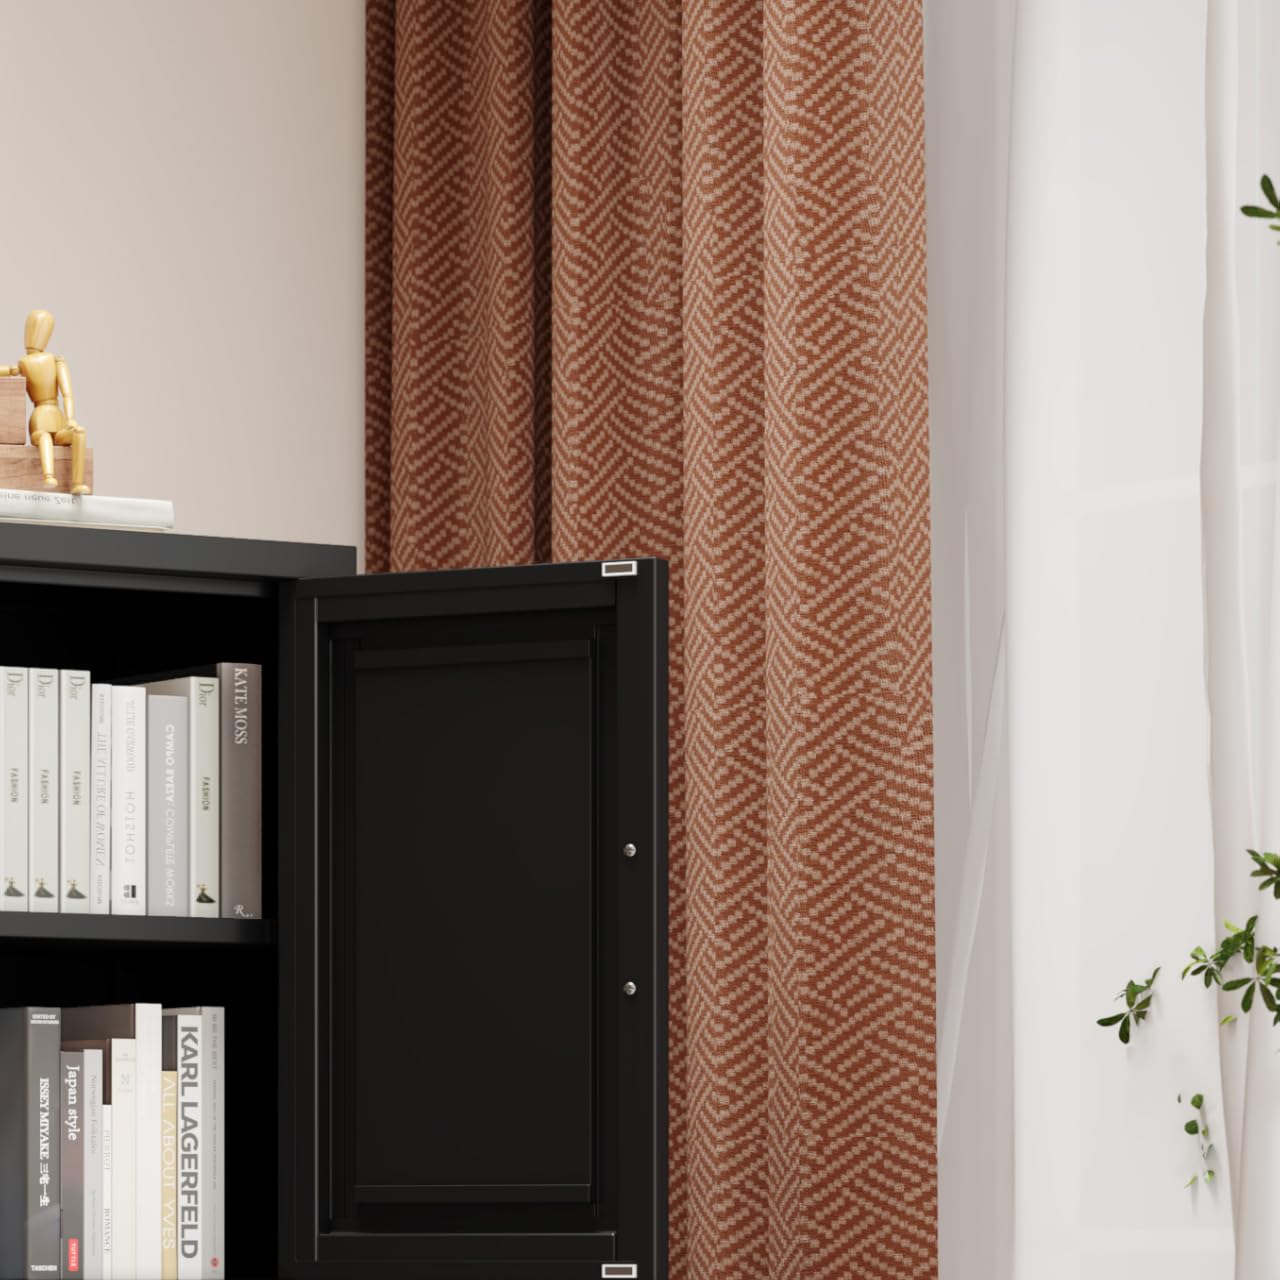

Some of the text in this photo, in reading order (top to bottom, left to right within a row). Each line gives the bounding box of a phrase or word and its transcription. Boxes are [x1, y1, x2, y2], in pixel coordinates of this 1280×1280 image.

[7, 672, 23, 696] Dior
[37, 674, 54, 698] Dior
[70, 675, 85, 700] Dior
[199, 682, 215, 706] Dior
[234, 667, 248, 745] KATE MOSS
[10, 768, 19, 803] FASHION
[40, 769, 49, 804] FASHION
[73, 770, 82, 805] FASHION
[202, 777, 211, 812] FASHION
[39, 1077, 49, 1160] ISSEY MIYAKE
[65, 1064, 80, 1141] Japan style
[181, 1026, 199, 1259] KARL LAGERFELD
[162, 1076, 176, 1249] ALL ABOUT YVES
